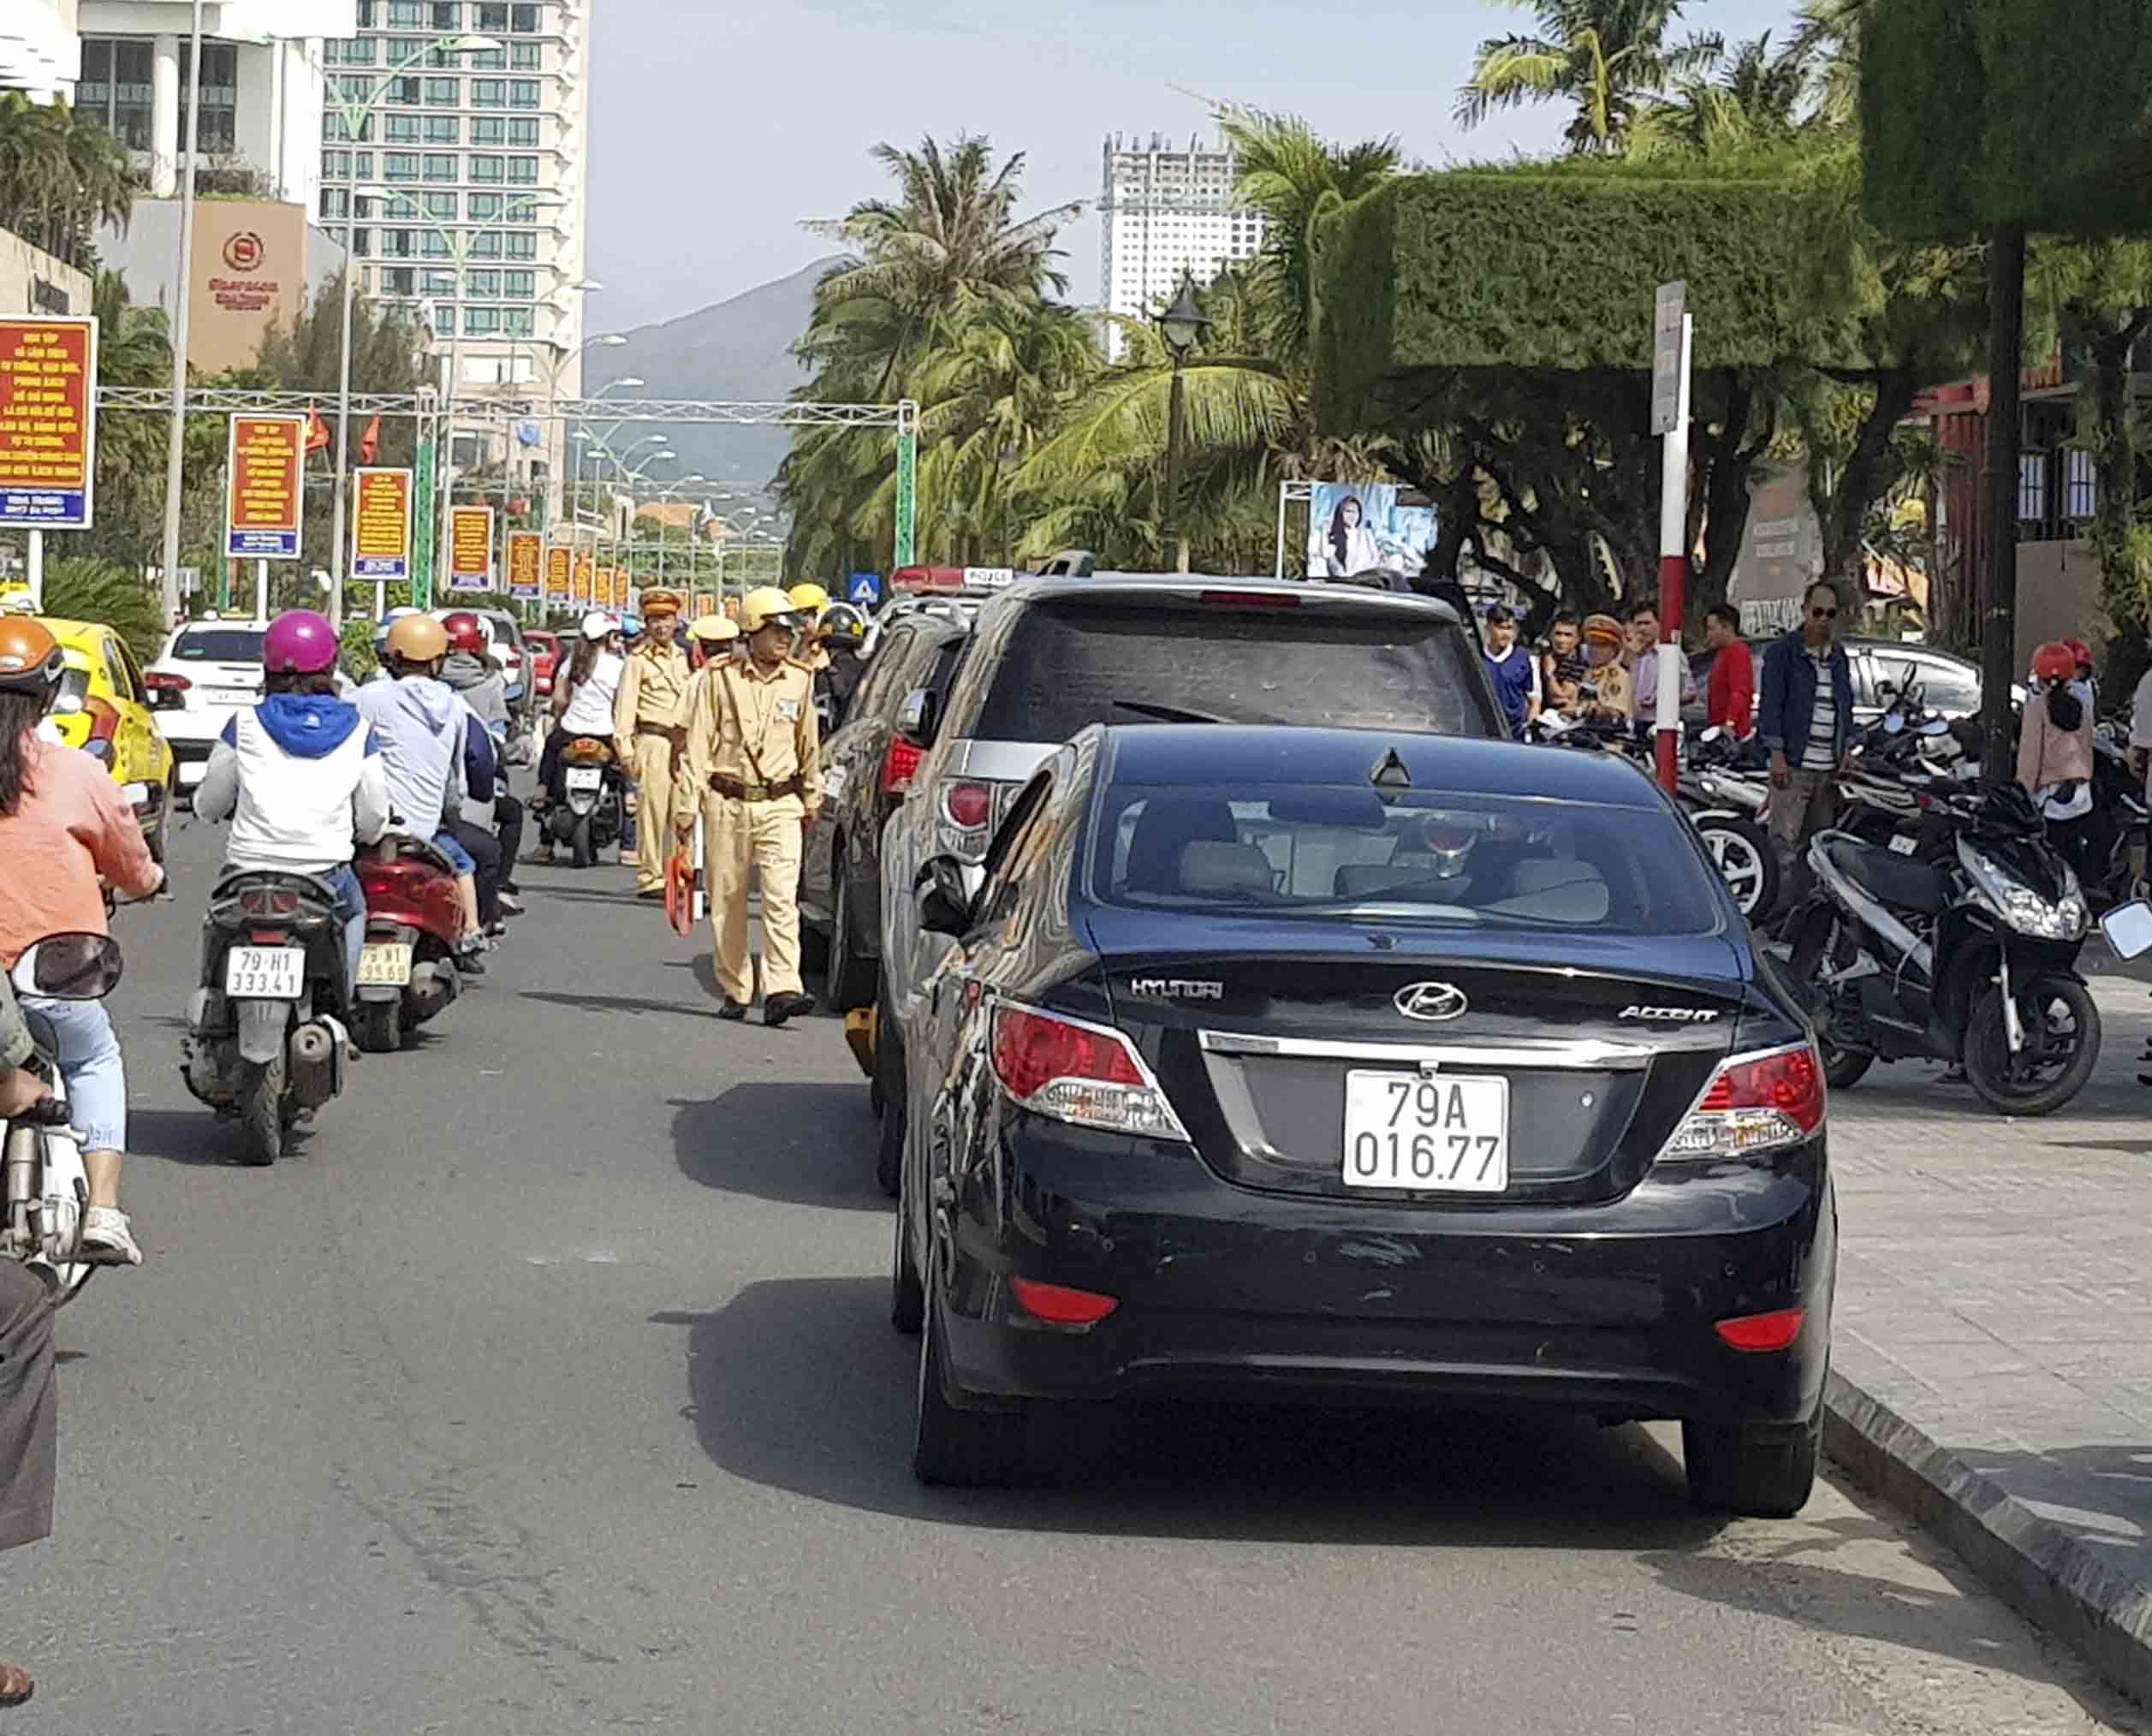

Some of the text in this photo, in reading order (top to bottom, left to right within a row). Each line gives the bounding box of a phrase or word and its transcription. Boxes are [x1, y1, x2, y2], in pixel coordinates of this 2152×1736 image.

[232, 972, 295, 994] 333.41
[1388, 1081, 1466, 1129] 79A
[1354, 1131, 1500, 1182] 016.77
